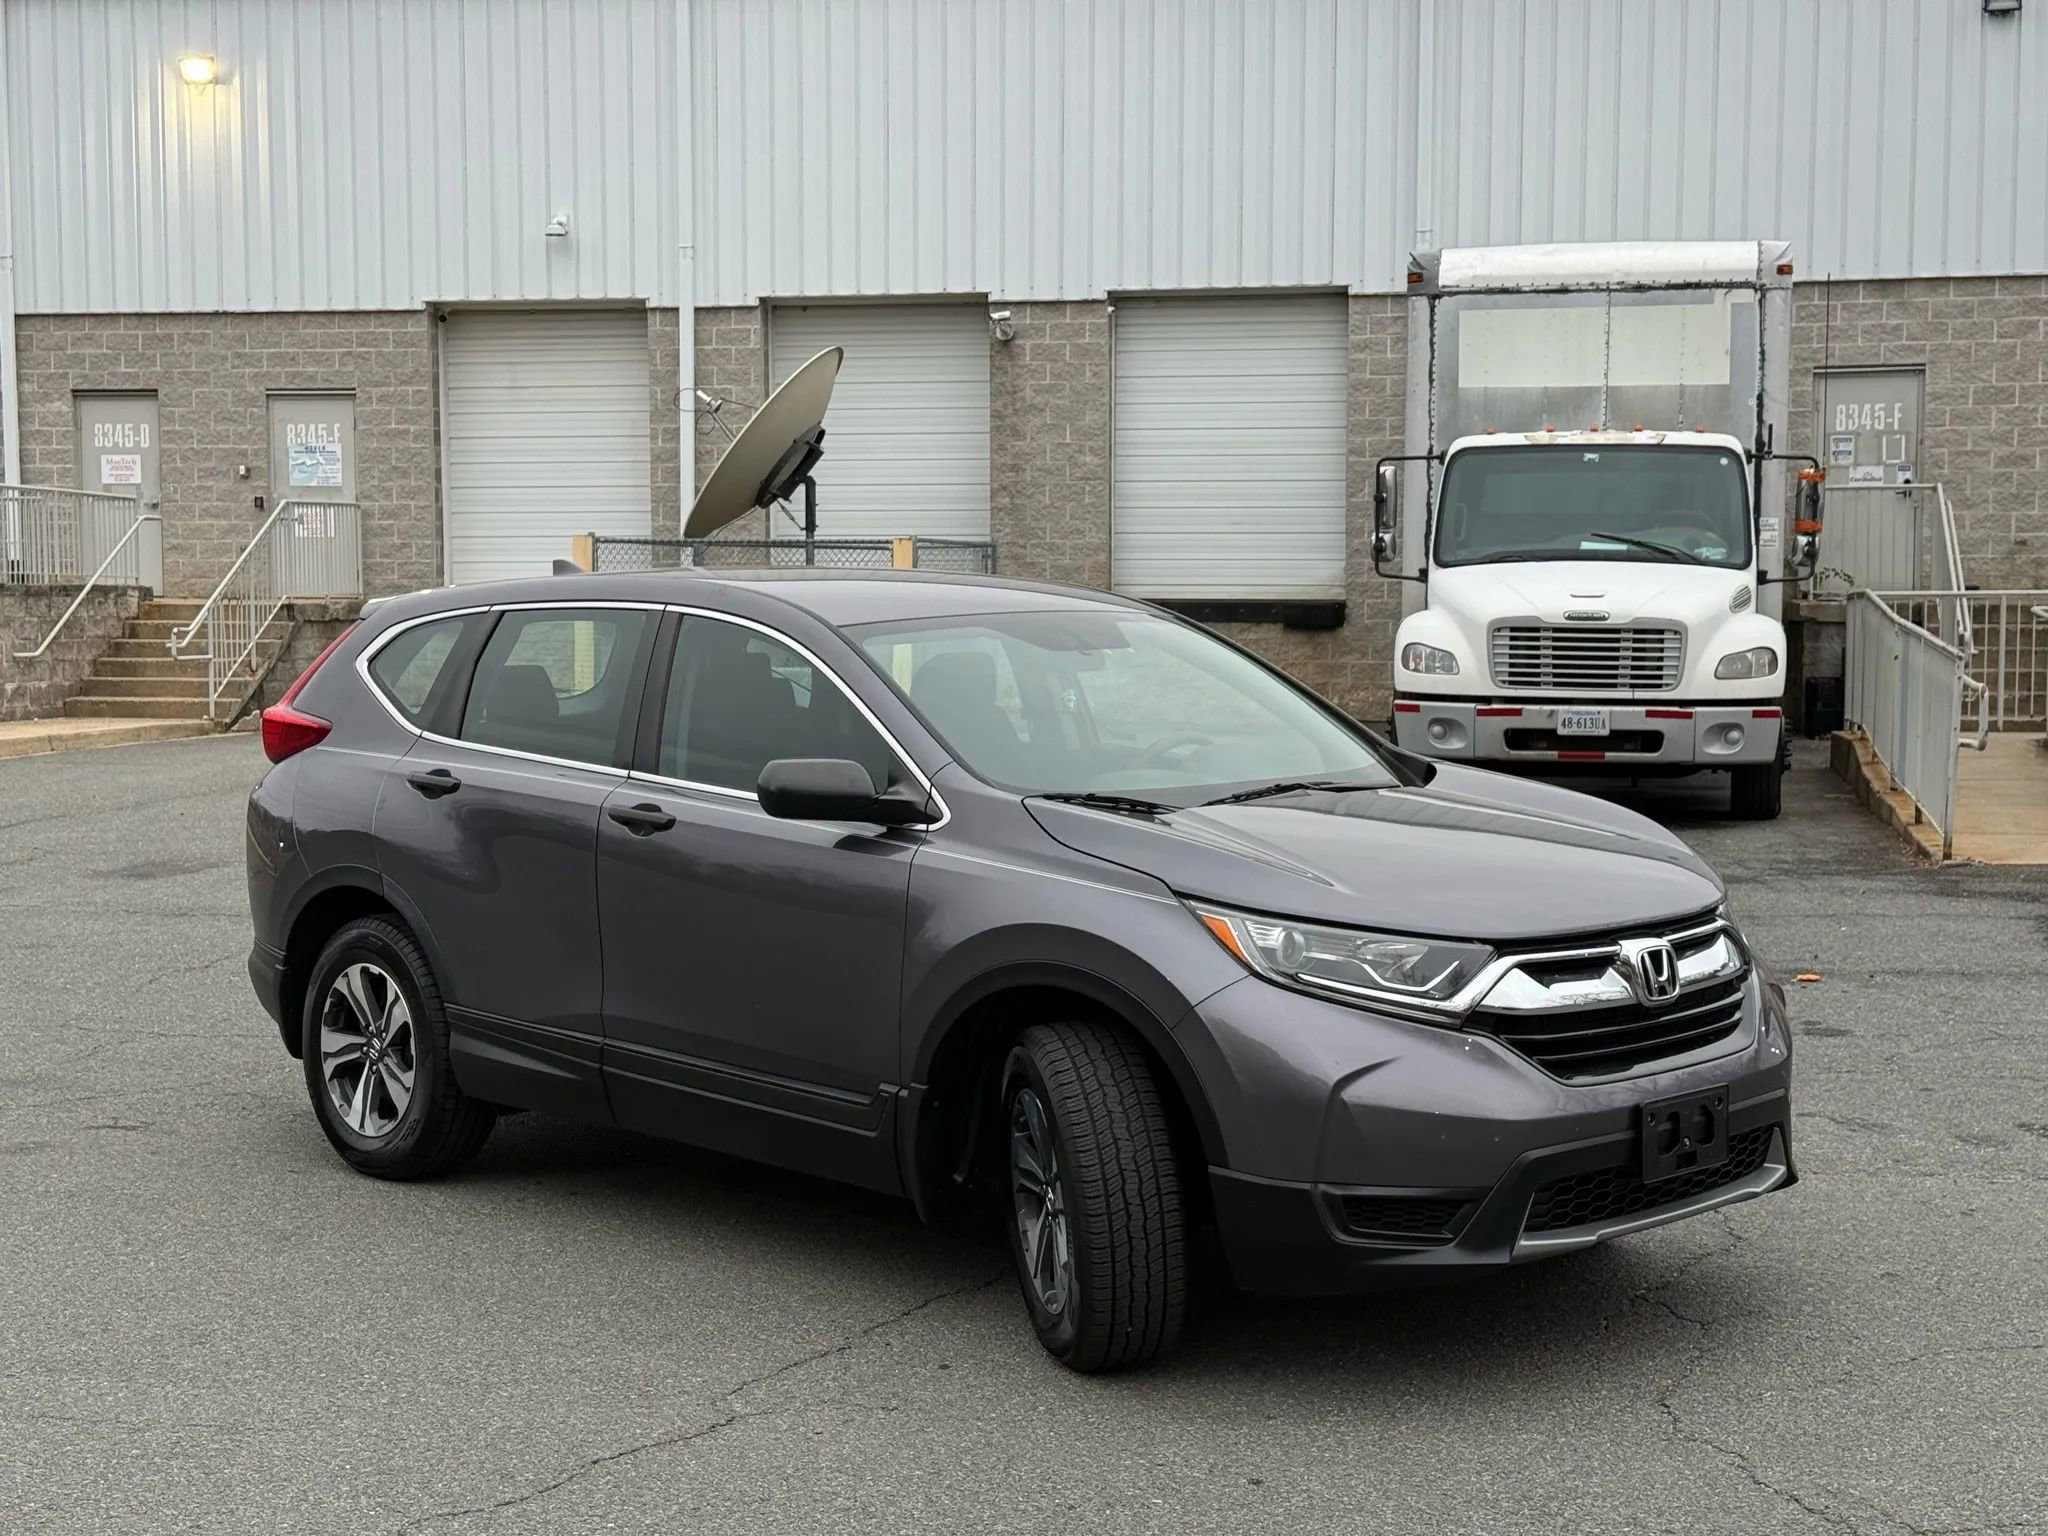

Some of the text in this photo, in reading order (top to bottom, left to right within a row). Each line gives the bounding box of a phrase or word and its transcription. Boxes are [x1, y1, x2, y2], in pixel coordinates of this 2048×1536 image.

[1836, 403, 1902, 431] 8345-F
[94, 423, 150, 448] 8345-D
[1561, 717, 1606, 730] 48-613UA
